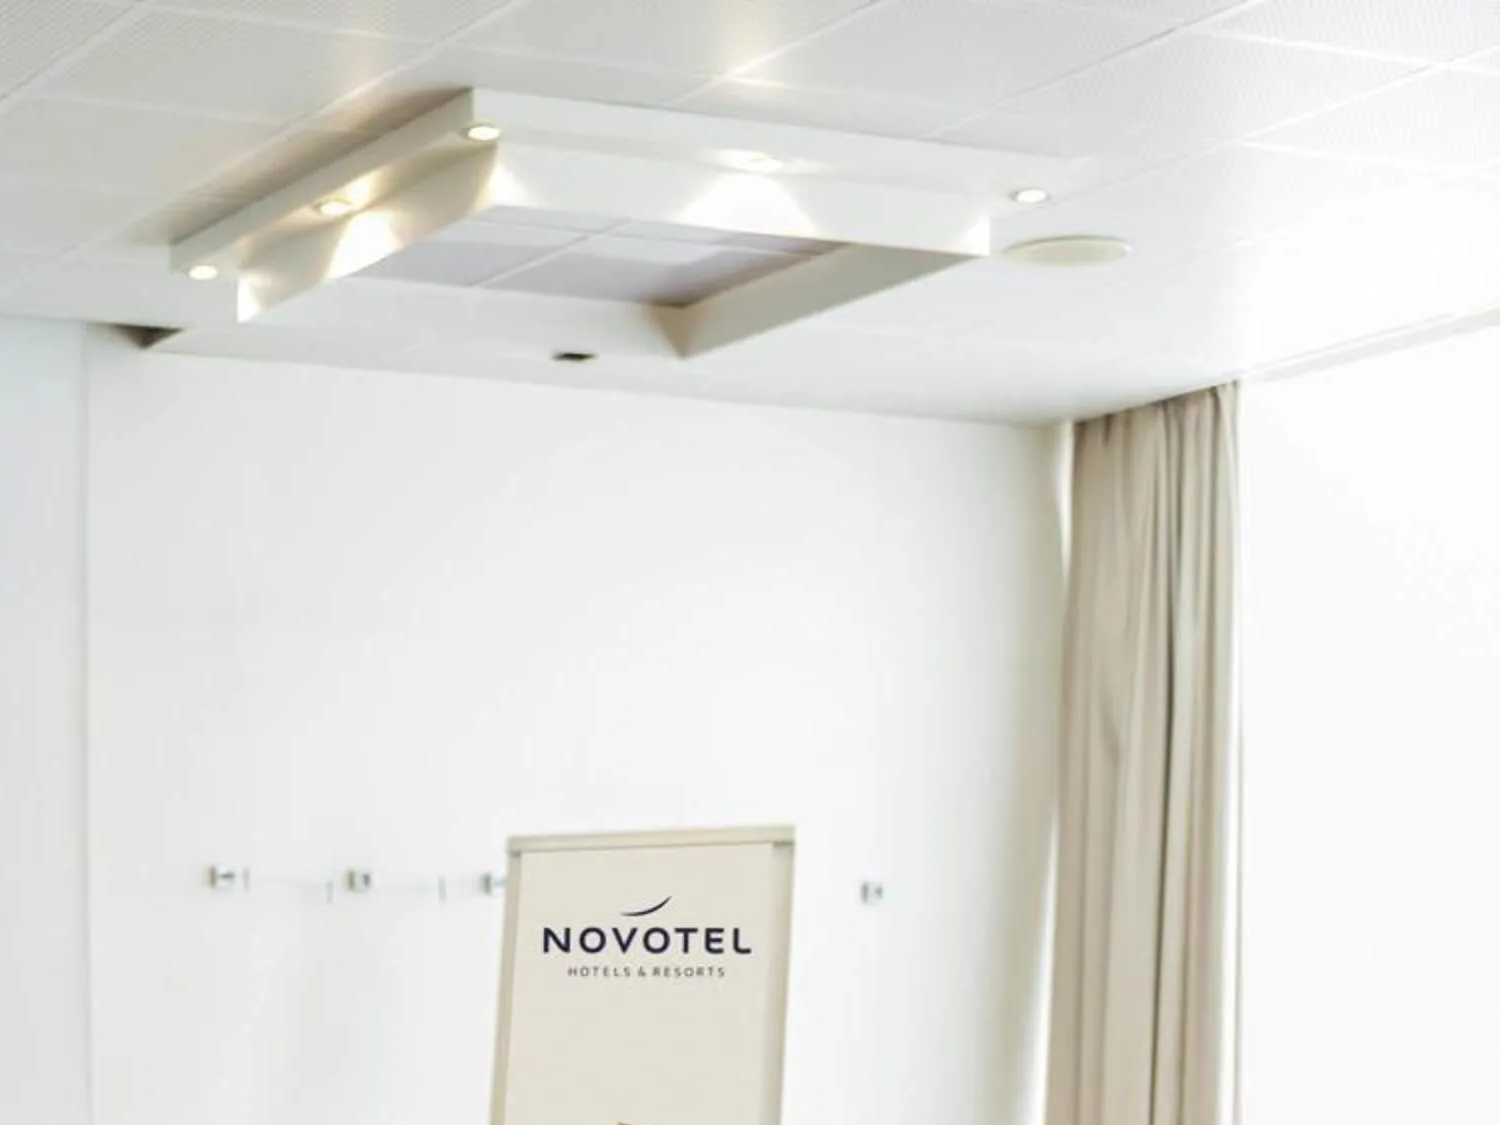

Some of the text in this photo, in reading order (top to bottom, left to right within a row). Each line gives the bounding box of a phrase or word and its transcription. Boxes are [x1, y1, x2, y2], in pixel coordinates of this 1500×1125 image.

[543, 926, 752, 955] NOVOTEL
[566, 965, 726, 979] HOTELS & RESORTS
